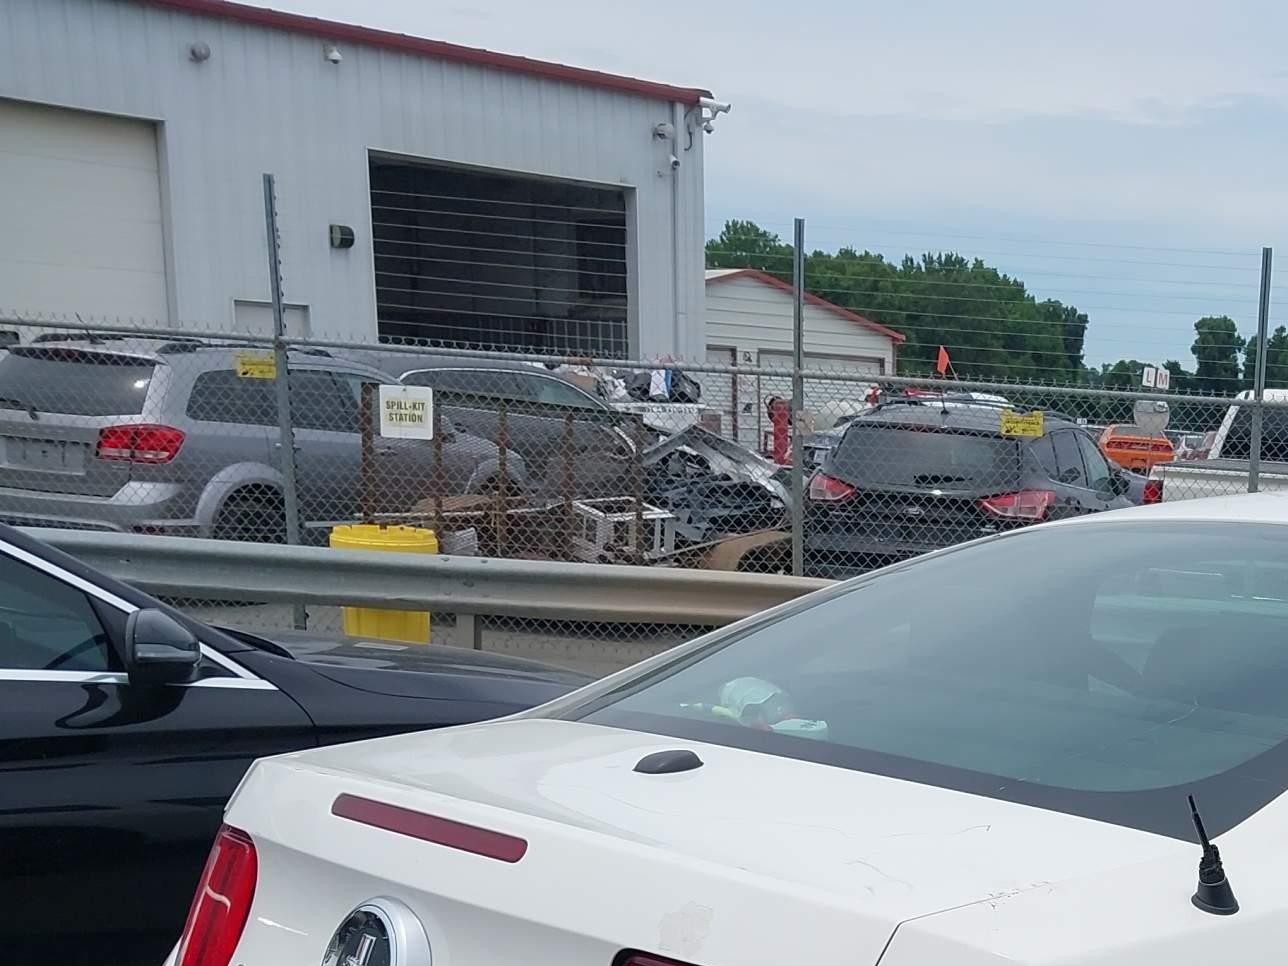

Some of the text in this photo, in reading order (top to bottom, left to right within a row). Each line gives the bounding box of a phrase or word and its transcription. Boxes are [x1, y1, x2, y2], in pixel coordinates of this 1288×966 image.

[1146, 369, 1168, 386] L M
[388, 412, 423, 423] STATION
